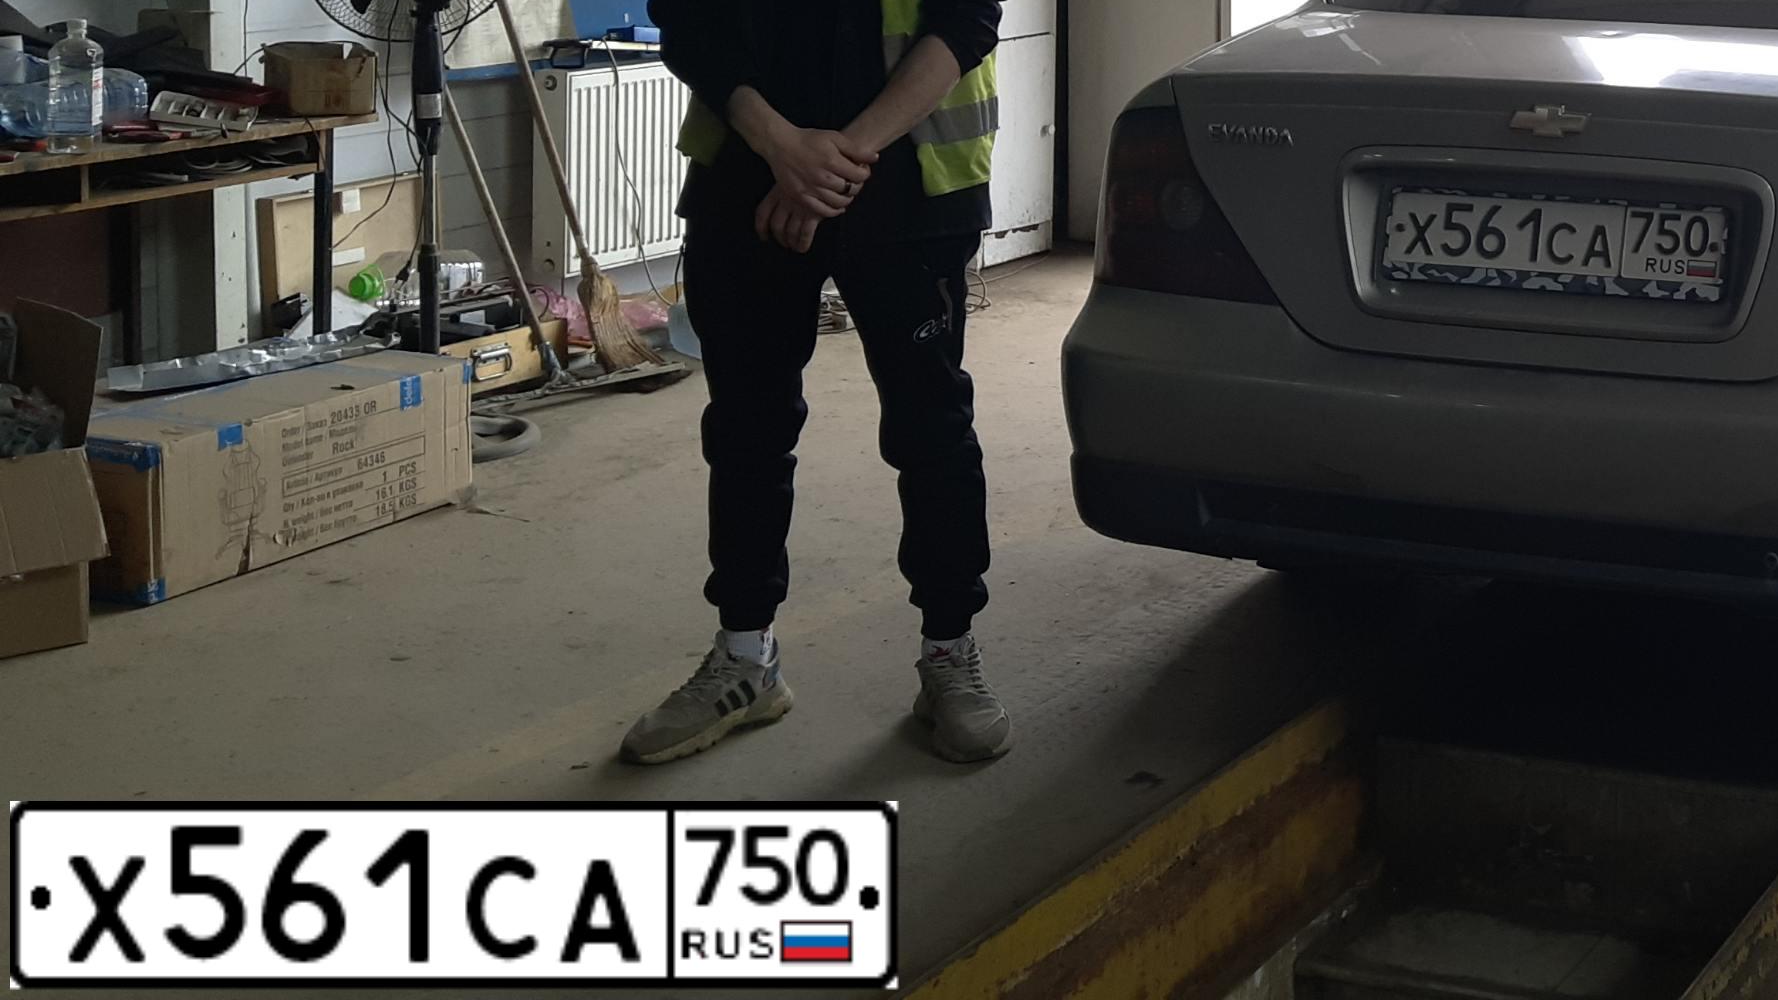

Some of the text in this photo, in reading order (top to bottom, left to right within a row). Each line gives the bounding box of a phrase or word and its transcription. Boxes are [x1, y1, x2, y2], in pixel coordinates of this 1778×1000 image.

[1207, 123, 1294, 147] EVANDA
[1630, 211, 1710, 257] 750
[1645, 258, 1686, 275] RUS
[399, 462, 417, 477] PCS
[399, 478, 417, 493] KGS
[399, 493, 417, 508] KGS
